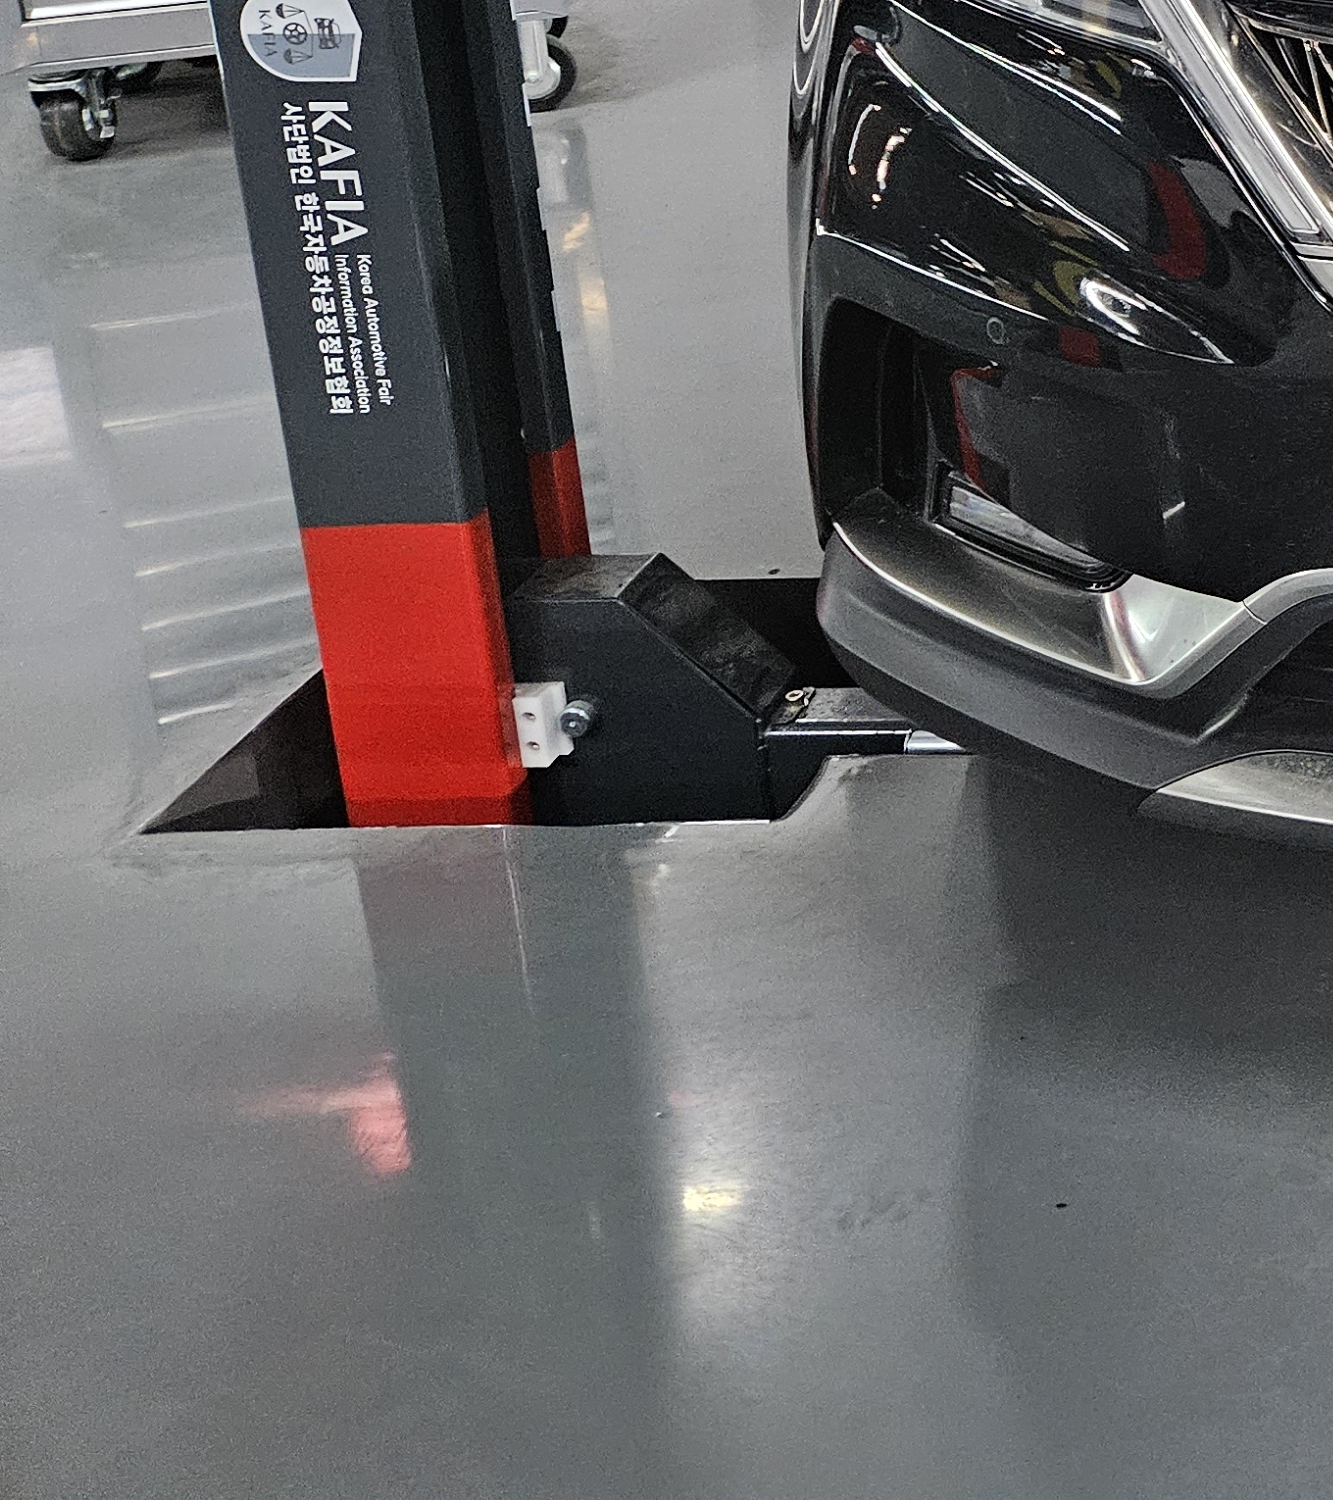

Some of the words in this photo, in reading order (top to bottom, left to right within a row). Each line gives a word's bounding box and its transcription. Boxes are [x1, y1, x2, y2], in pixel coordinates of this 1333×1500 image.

[258, 9, 278, 57] KAFIA
[280, 102, 317, 185] 사단법인
[308, 101, 369, 246] KAFIA
[294, 191, 354, 414] 한국자동차공정정보협회
[356, 254, 374, 295] Korea
[334, 254, 359, 334] Information
[347, 335, 372, 414] Association
[363, 297, 388, 377] Automotive
[376, 378, 395, 406] Fair
